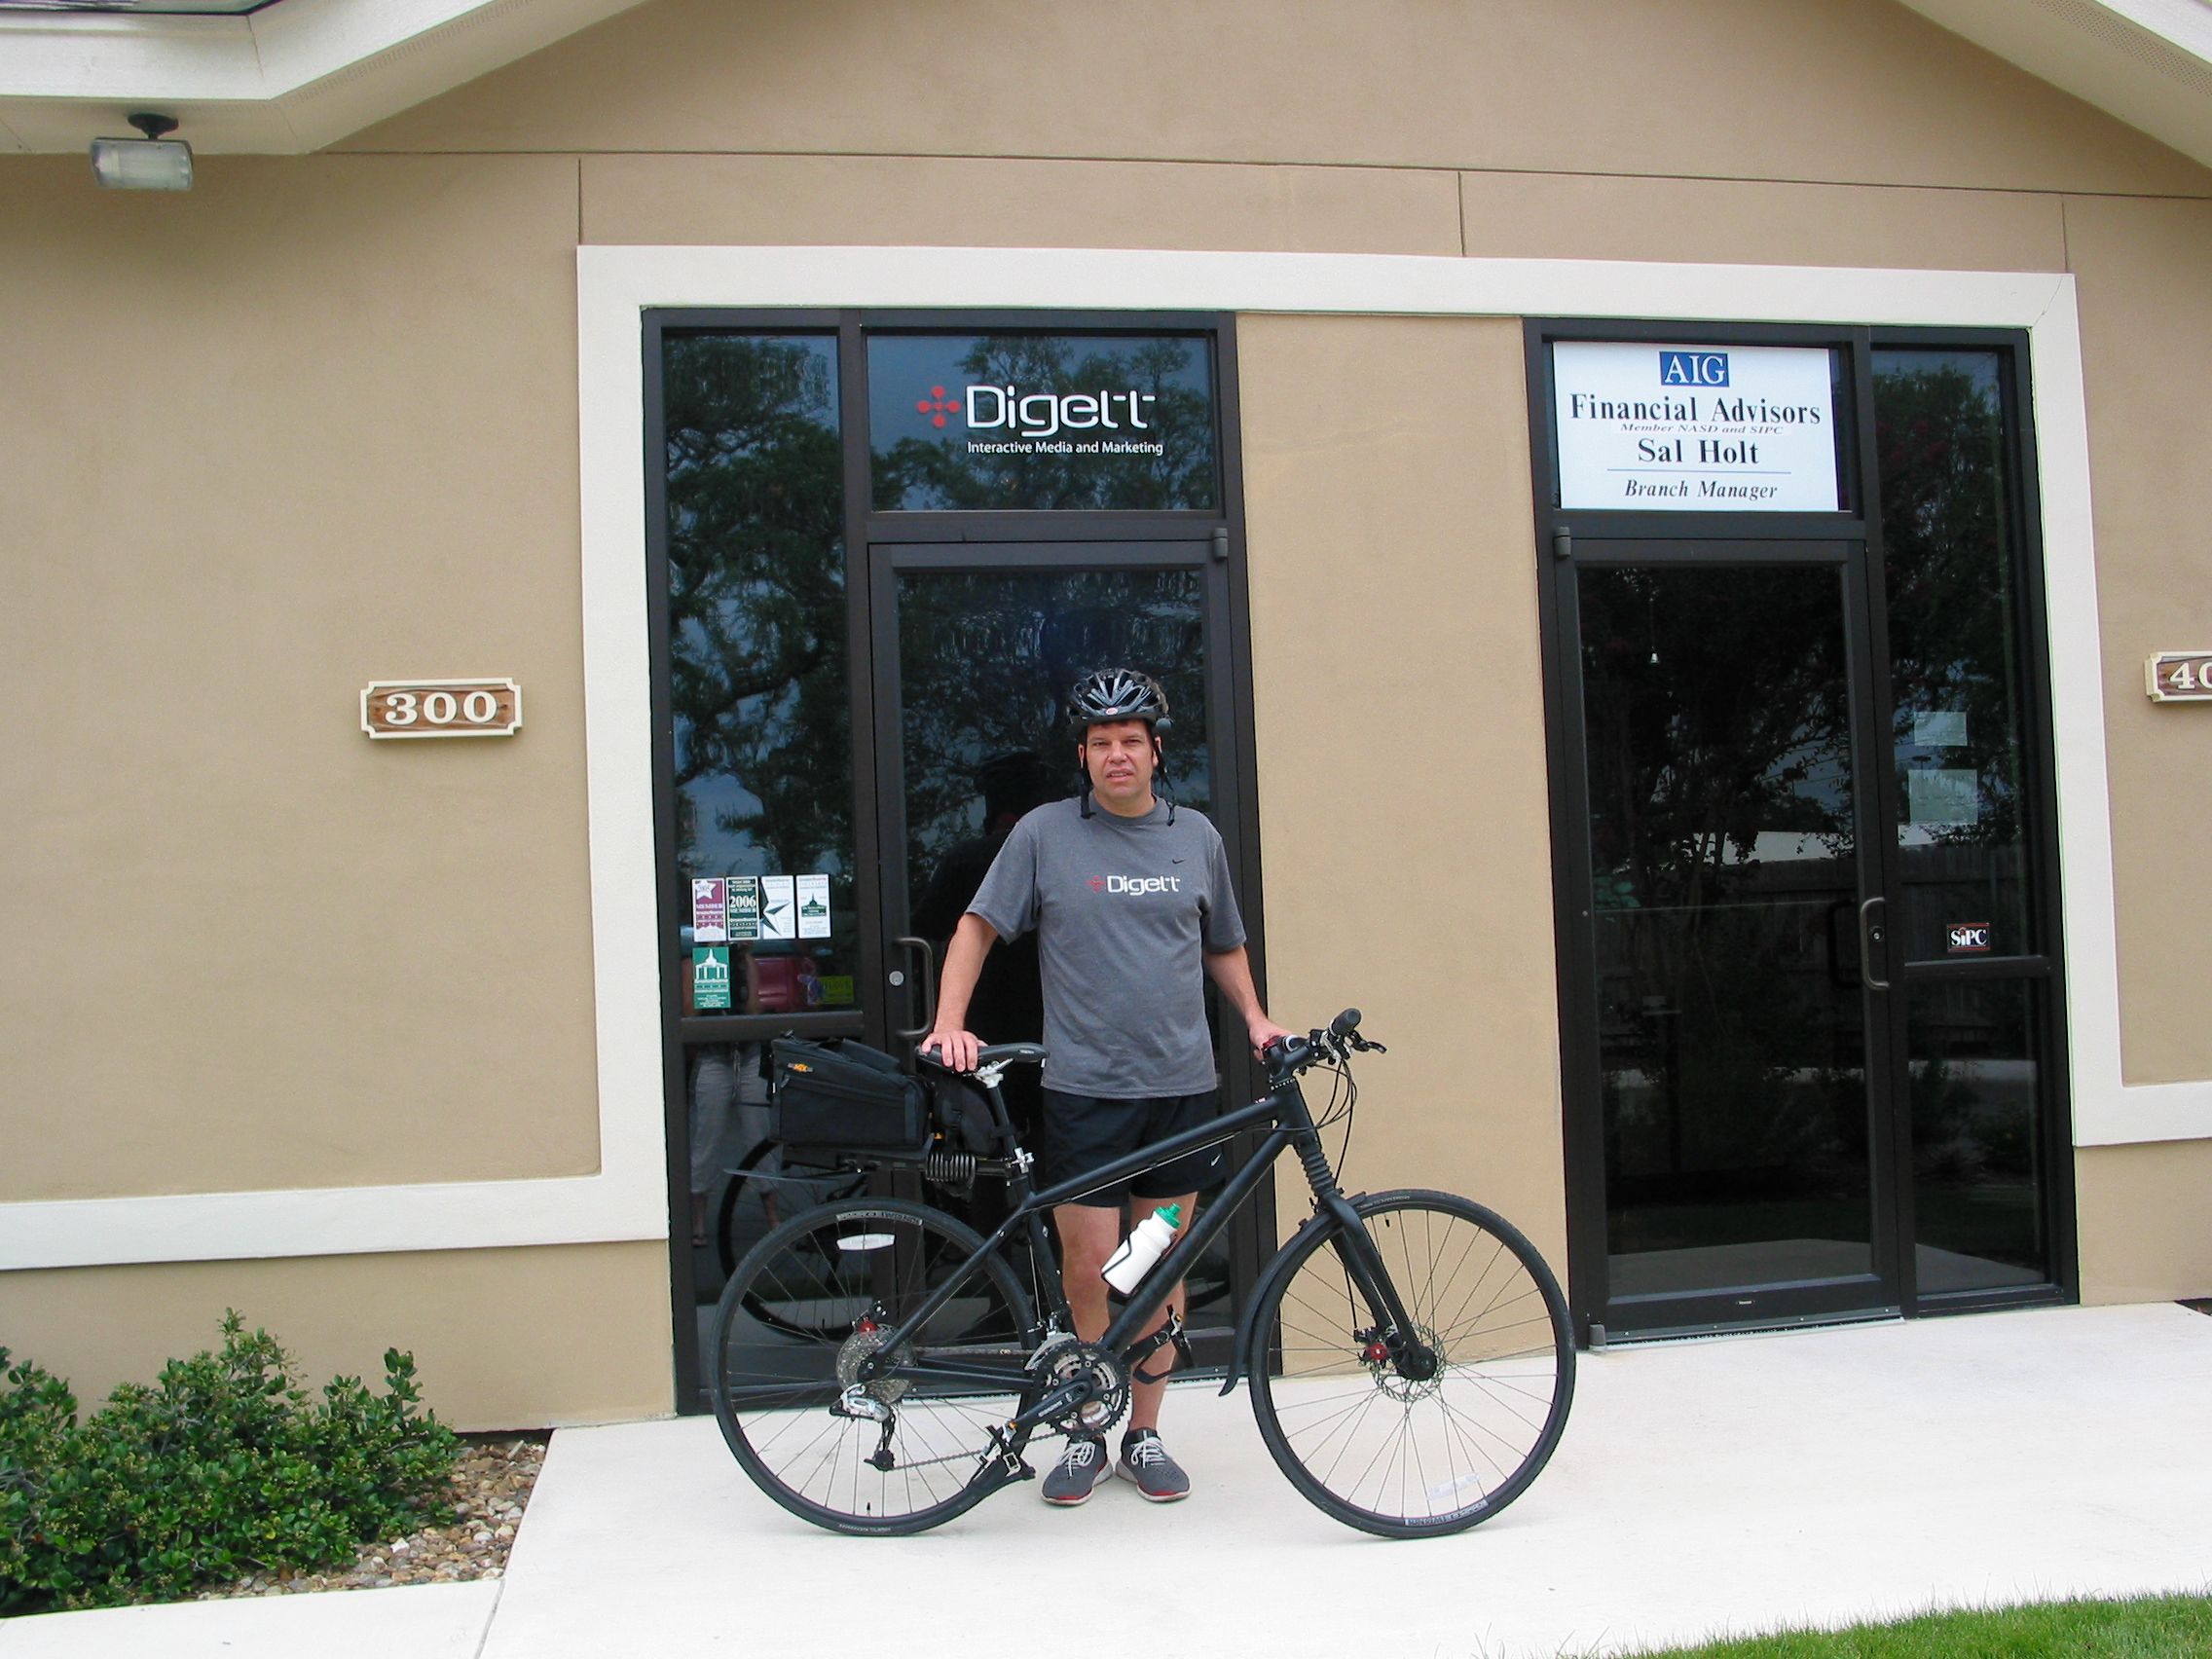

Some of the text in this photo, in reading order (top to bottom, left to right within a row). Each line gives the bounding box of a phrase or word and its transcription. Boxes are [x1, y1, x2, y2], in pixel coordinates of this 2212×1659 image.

[1664, 354, 1725, 385] AIG
[966, 386, 1156, 437] Digett
[1570, 393, 1821, 424] Financial Advisors
[1620, 423, 1784, 435] Member NASD and SIPC
[967, 441, 1163, 457] Interactive Media and Marketing
[1639, 438, 1759, 464] Sal Holt
[1625, 479, 1778, 501] Branch Manager
[385, 690, 498, 725] 300
[1106, 875, 1181, 897] Digett
[729, 895, 756, 908] 2006
